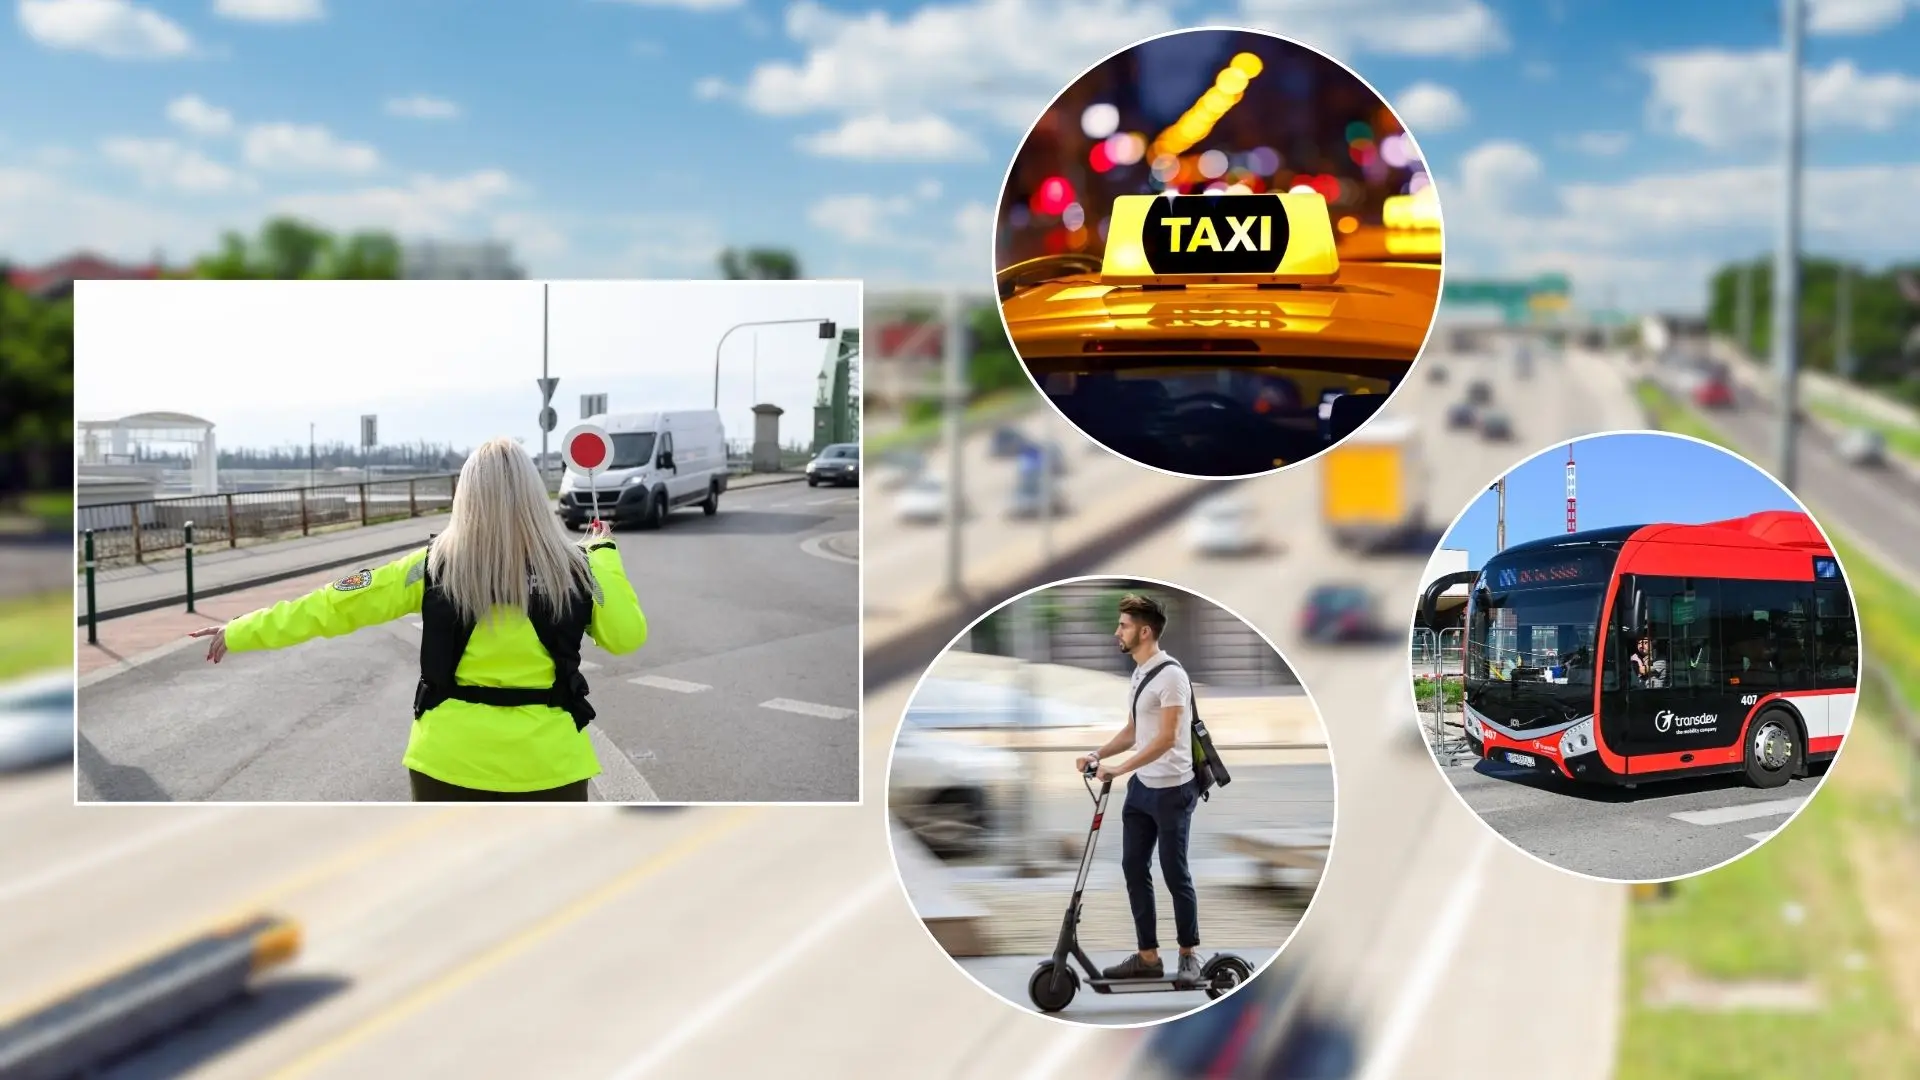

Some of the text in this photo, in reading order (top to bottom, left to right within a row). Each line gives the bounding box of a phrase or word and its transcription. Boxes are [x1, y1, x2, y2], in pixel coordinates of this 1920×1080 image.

[1160, 215, 1272, 252] TAXI
[1741, 695, 1758, 706] 407
[1674, 712, 1718, 727] transdev
[1484, 729, 1497, 740] 407
